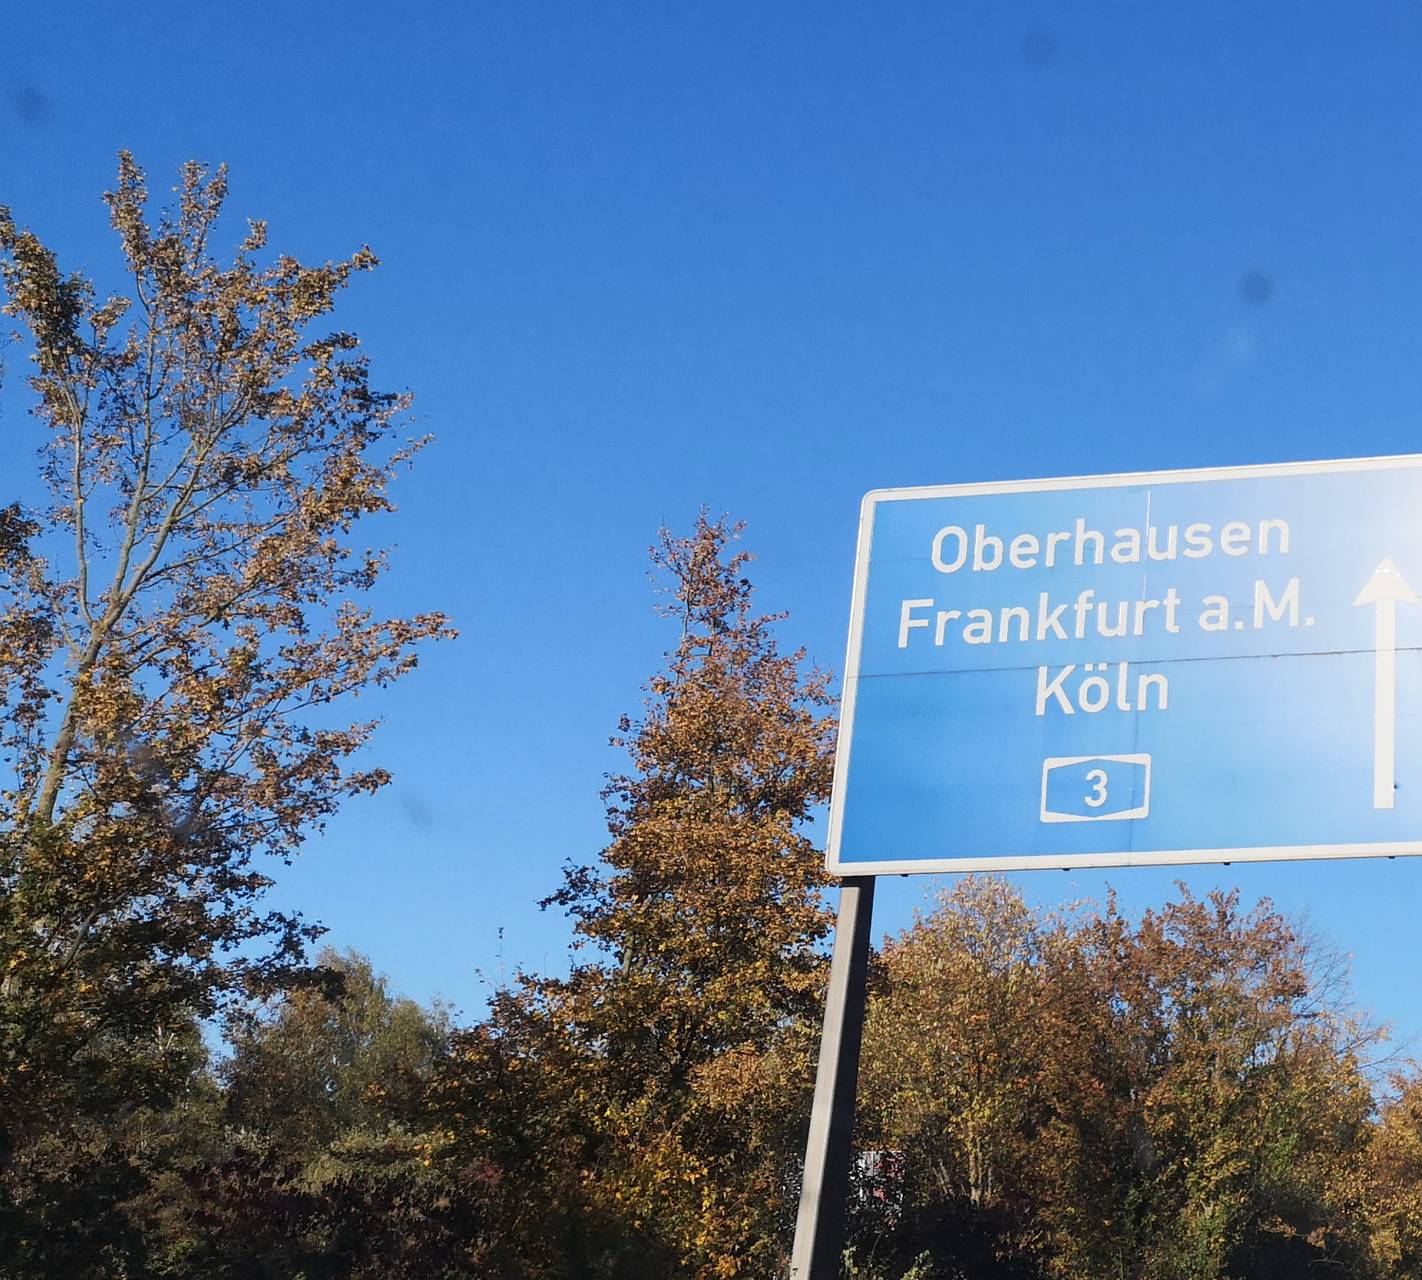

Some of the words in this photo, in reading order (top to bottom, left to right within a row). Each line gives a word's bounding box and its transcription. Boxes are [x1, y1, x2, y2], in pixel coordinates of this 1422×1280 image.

[931, 517, 1291, 574] Oberhausen
[897, 588, 1181, 649] Frankfurt
[1199, 577, 1316, 632] a.M.
[1035, 661, 1170, 716] Köln
[1083, 768, 1109, 808] 3
